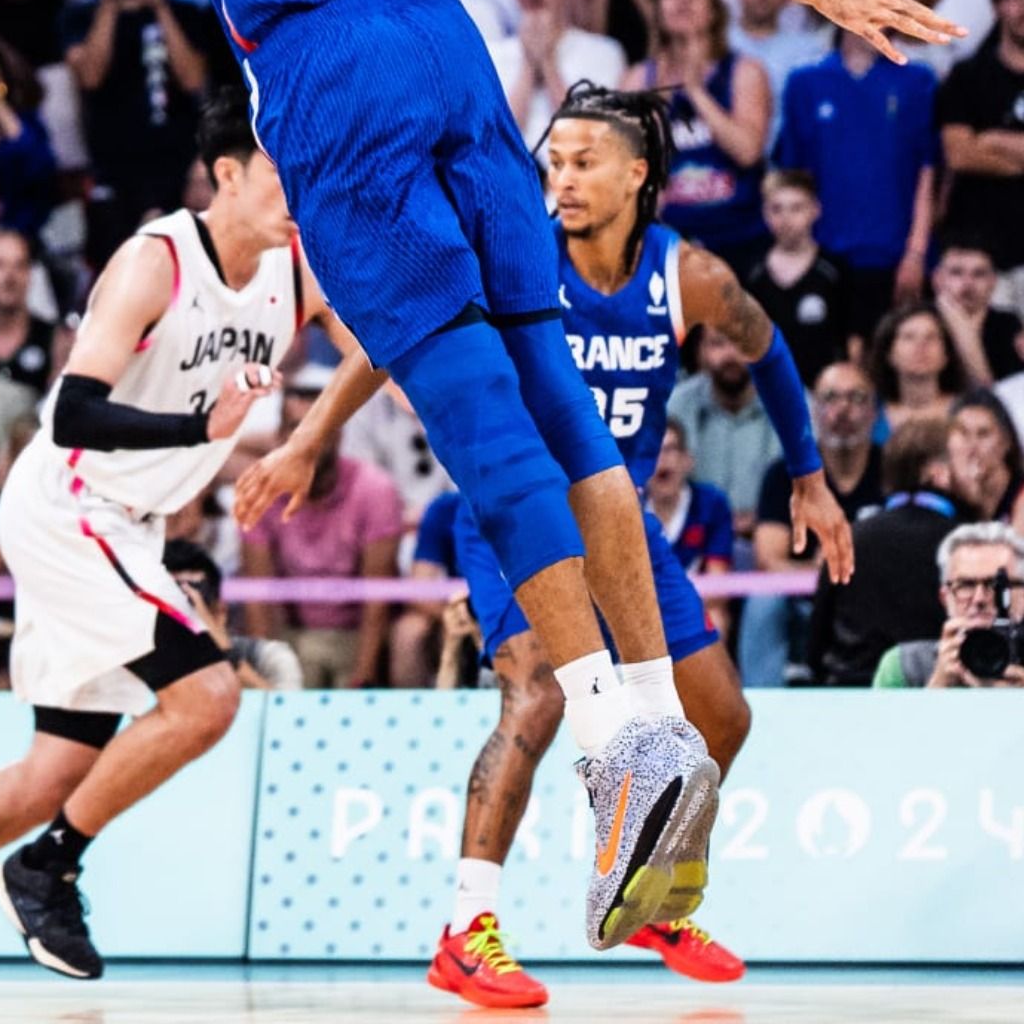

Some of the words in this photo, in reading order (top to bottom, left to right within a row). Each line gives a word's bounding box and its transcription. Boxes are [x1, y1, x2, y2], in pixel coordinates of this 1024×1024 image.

[179, 326, 275, 371] JAPAN
[564, 333, 670, 371] RANCE
[720, 786, 1024, 860] 2024
